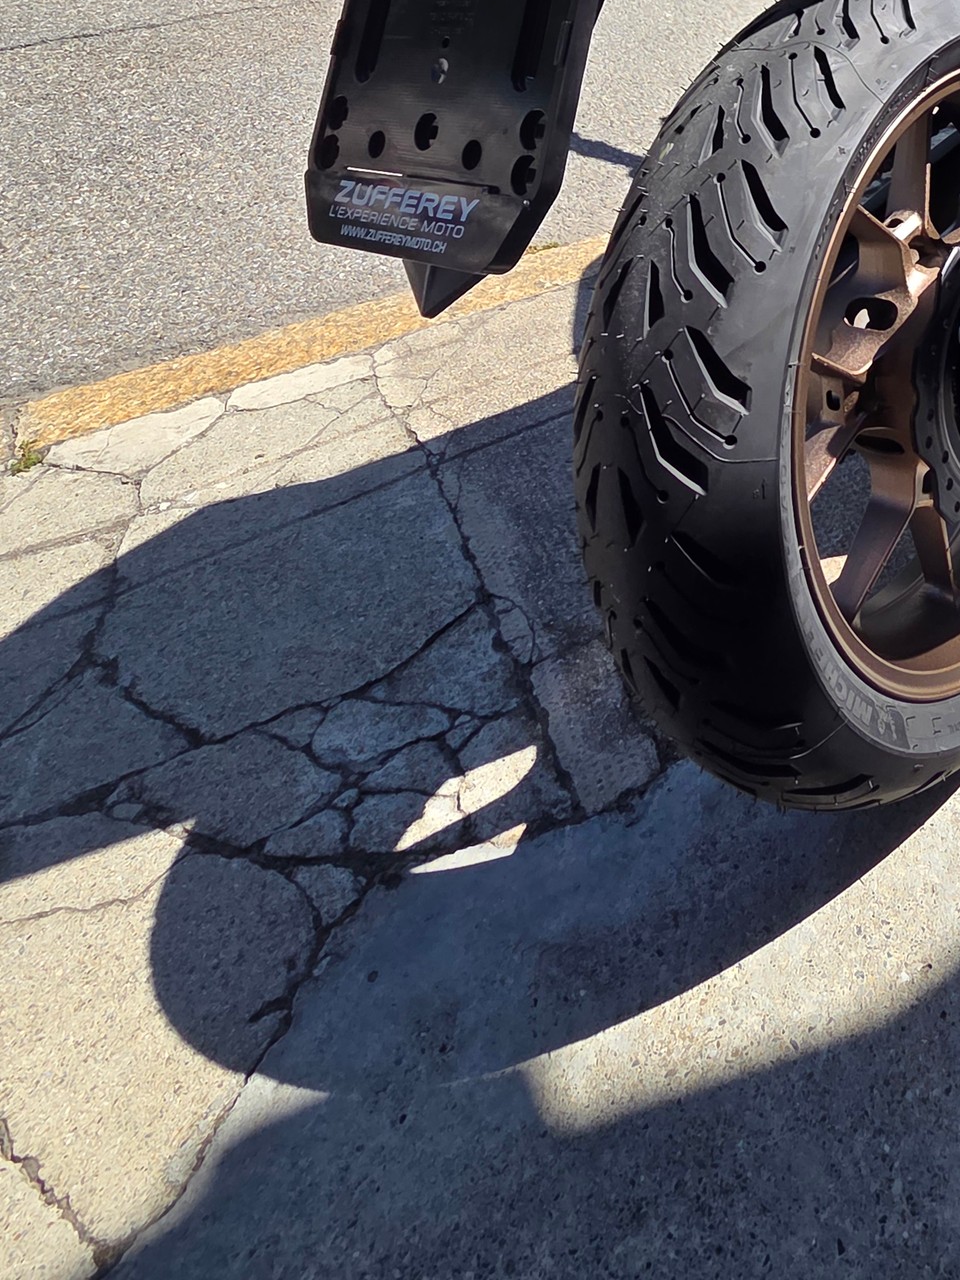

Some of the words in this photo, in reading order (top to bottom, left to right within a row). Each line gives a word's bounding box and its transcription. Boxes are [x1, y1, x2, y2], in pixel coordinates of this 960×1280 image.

[334, 179, 480, 222] ZUFFEREY
[340, 224, 448, 254] WWW.ZUFFEREYMOTO.CH
[420, 219, 465, 239] MOTO
[797, 604, 873, 726] MICHELI
